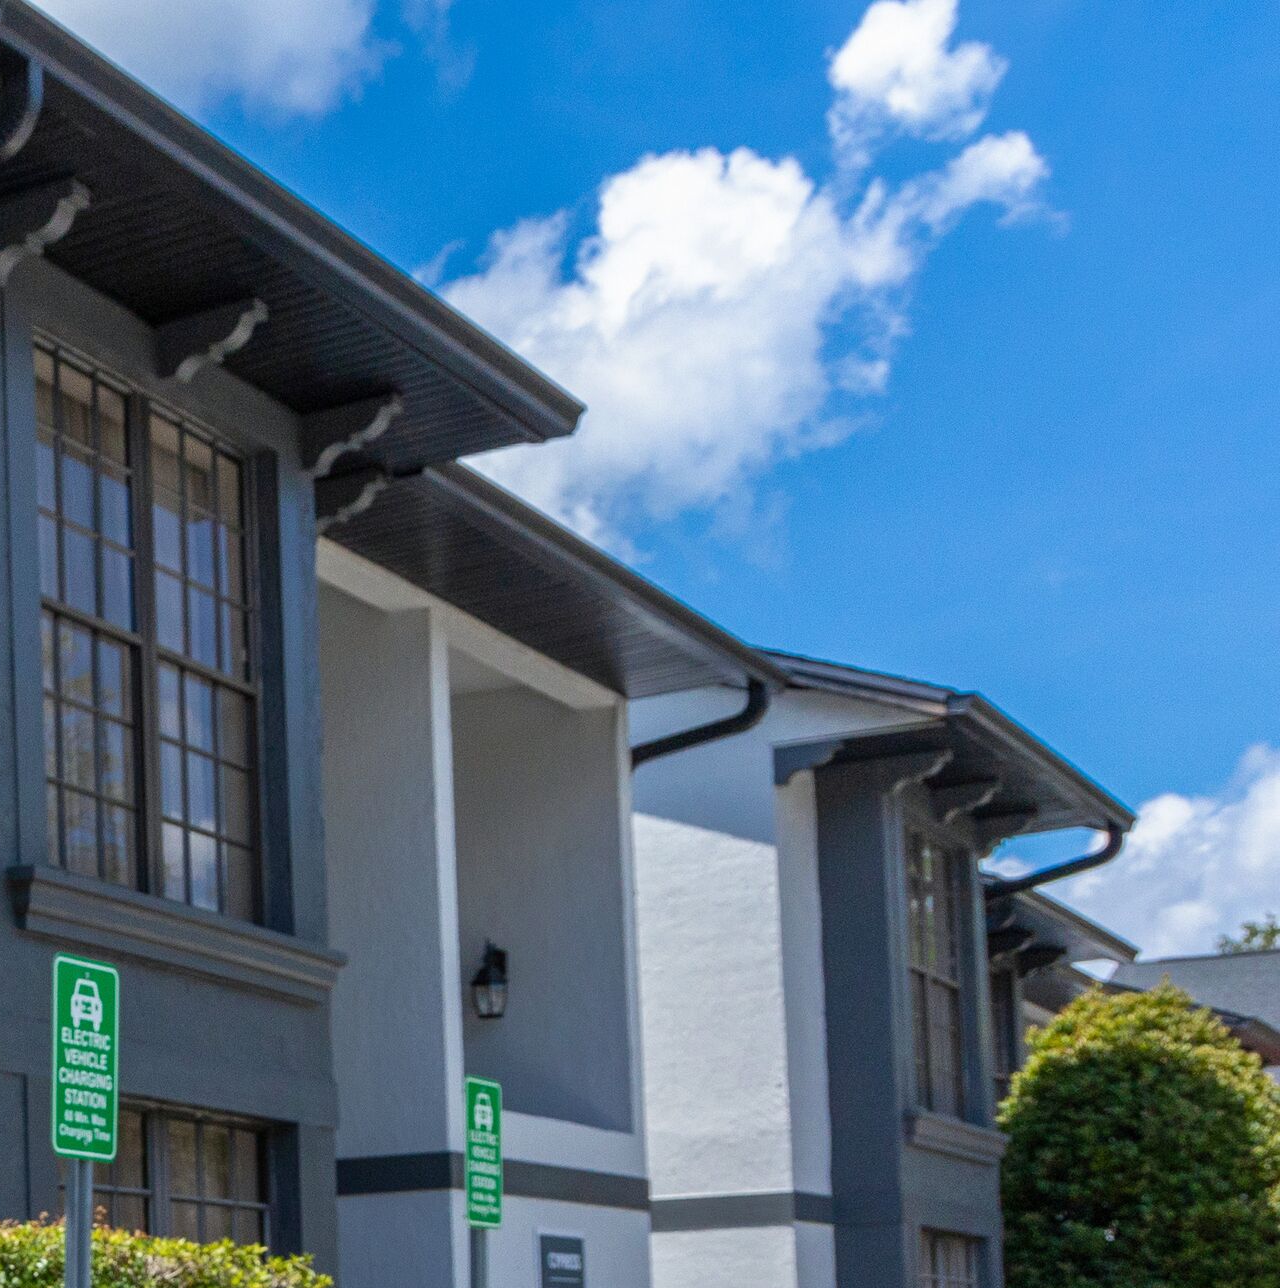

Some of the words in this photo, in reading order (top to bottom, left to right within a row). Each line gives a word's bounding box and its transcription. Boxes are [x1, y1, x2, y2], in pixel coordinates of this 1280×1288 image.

[61, 1026, 111, 1050] ELECTRIC
[64, 1048, 108, 1071] VEHICLE
[59, 1066, 113, 1091] CHARGING
[64, 1088, 107, 1109] STATION
